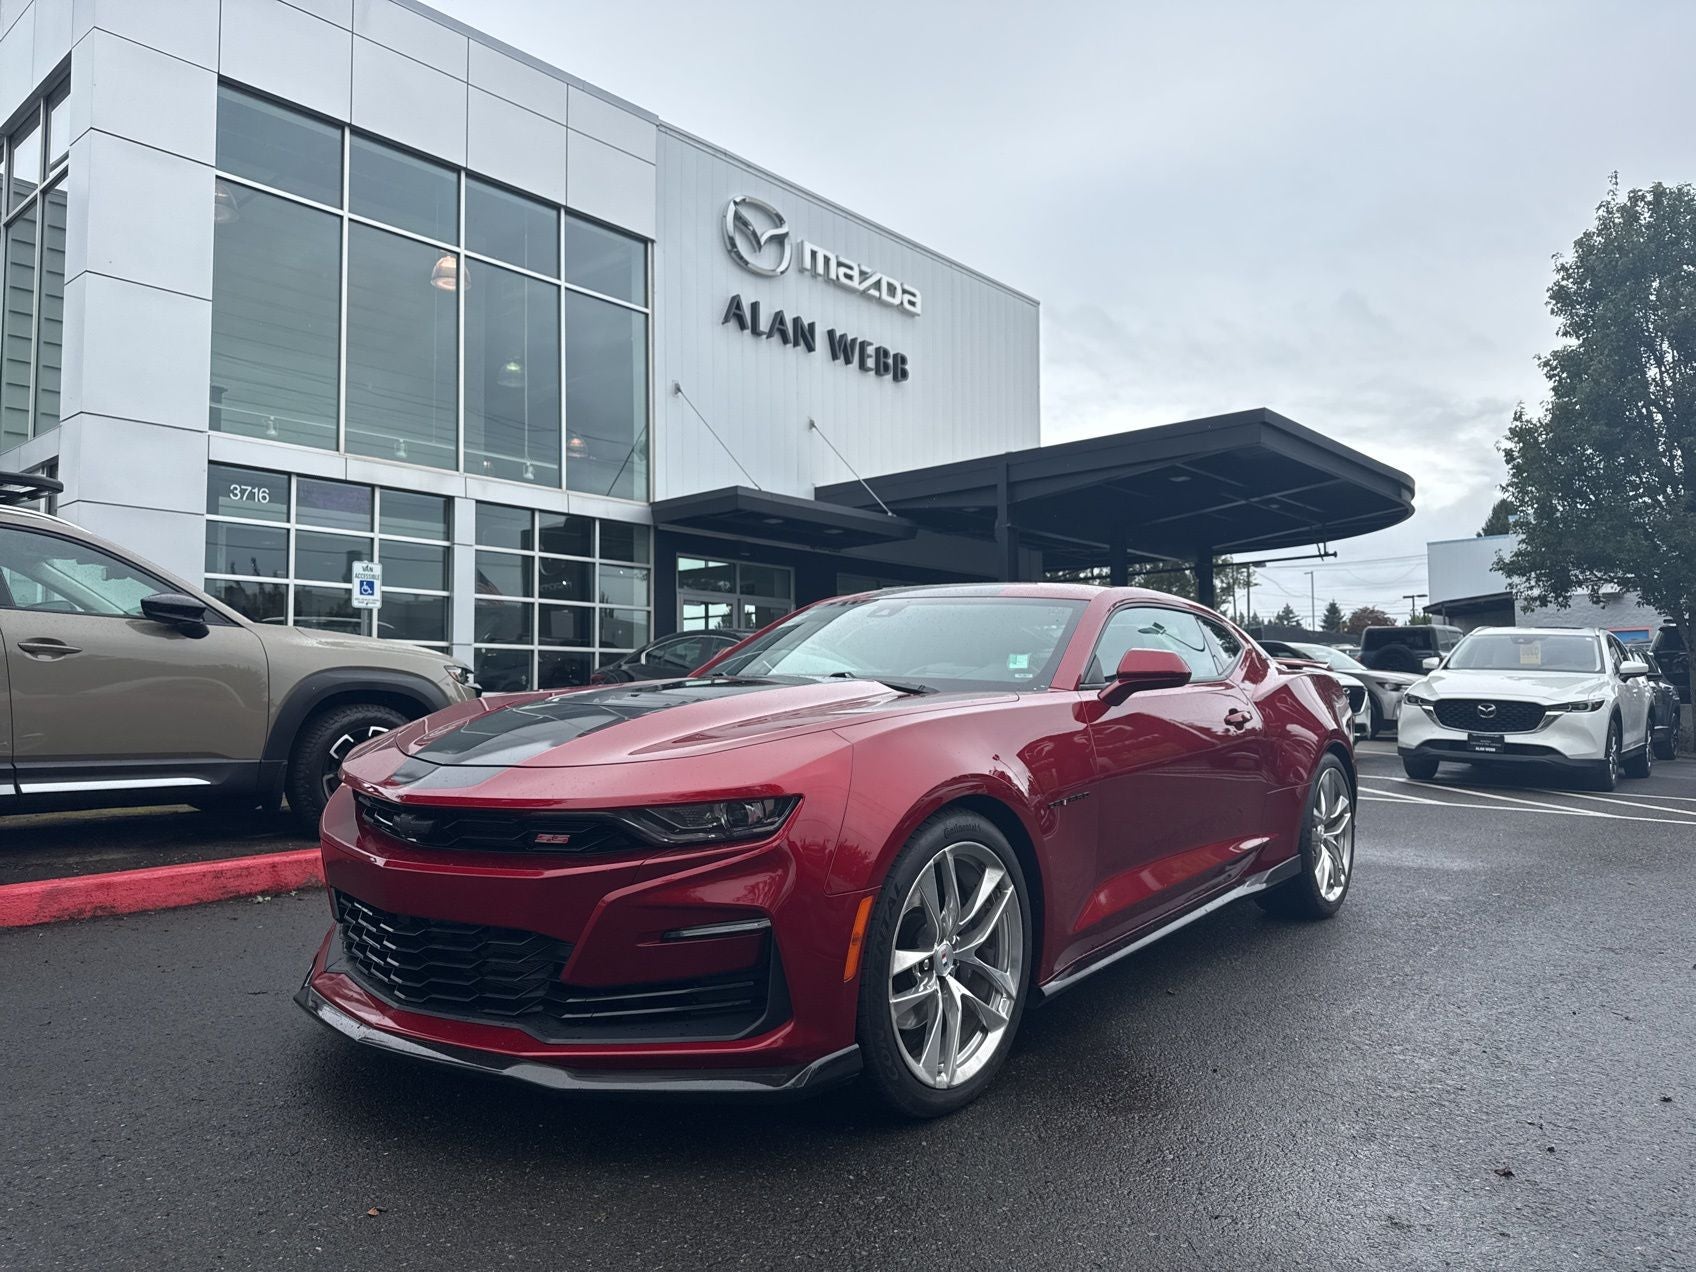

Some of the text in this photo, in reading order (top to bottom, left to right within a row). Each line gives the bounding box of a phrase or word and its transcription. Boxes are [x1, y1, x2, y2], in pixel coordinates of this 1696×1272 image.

[721, 293, 910, 383] ALAN WEBB
[229, 484, 270, 504] 3716
